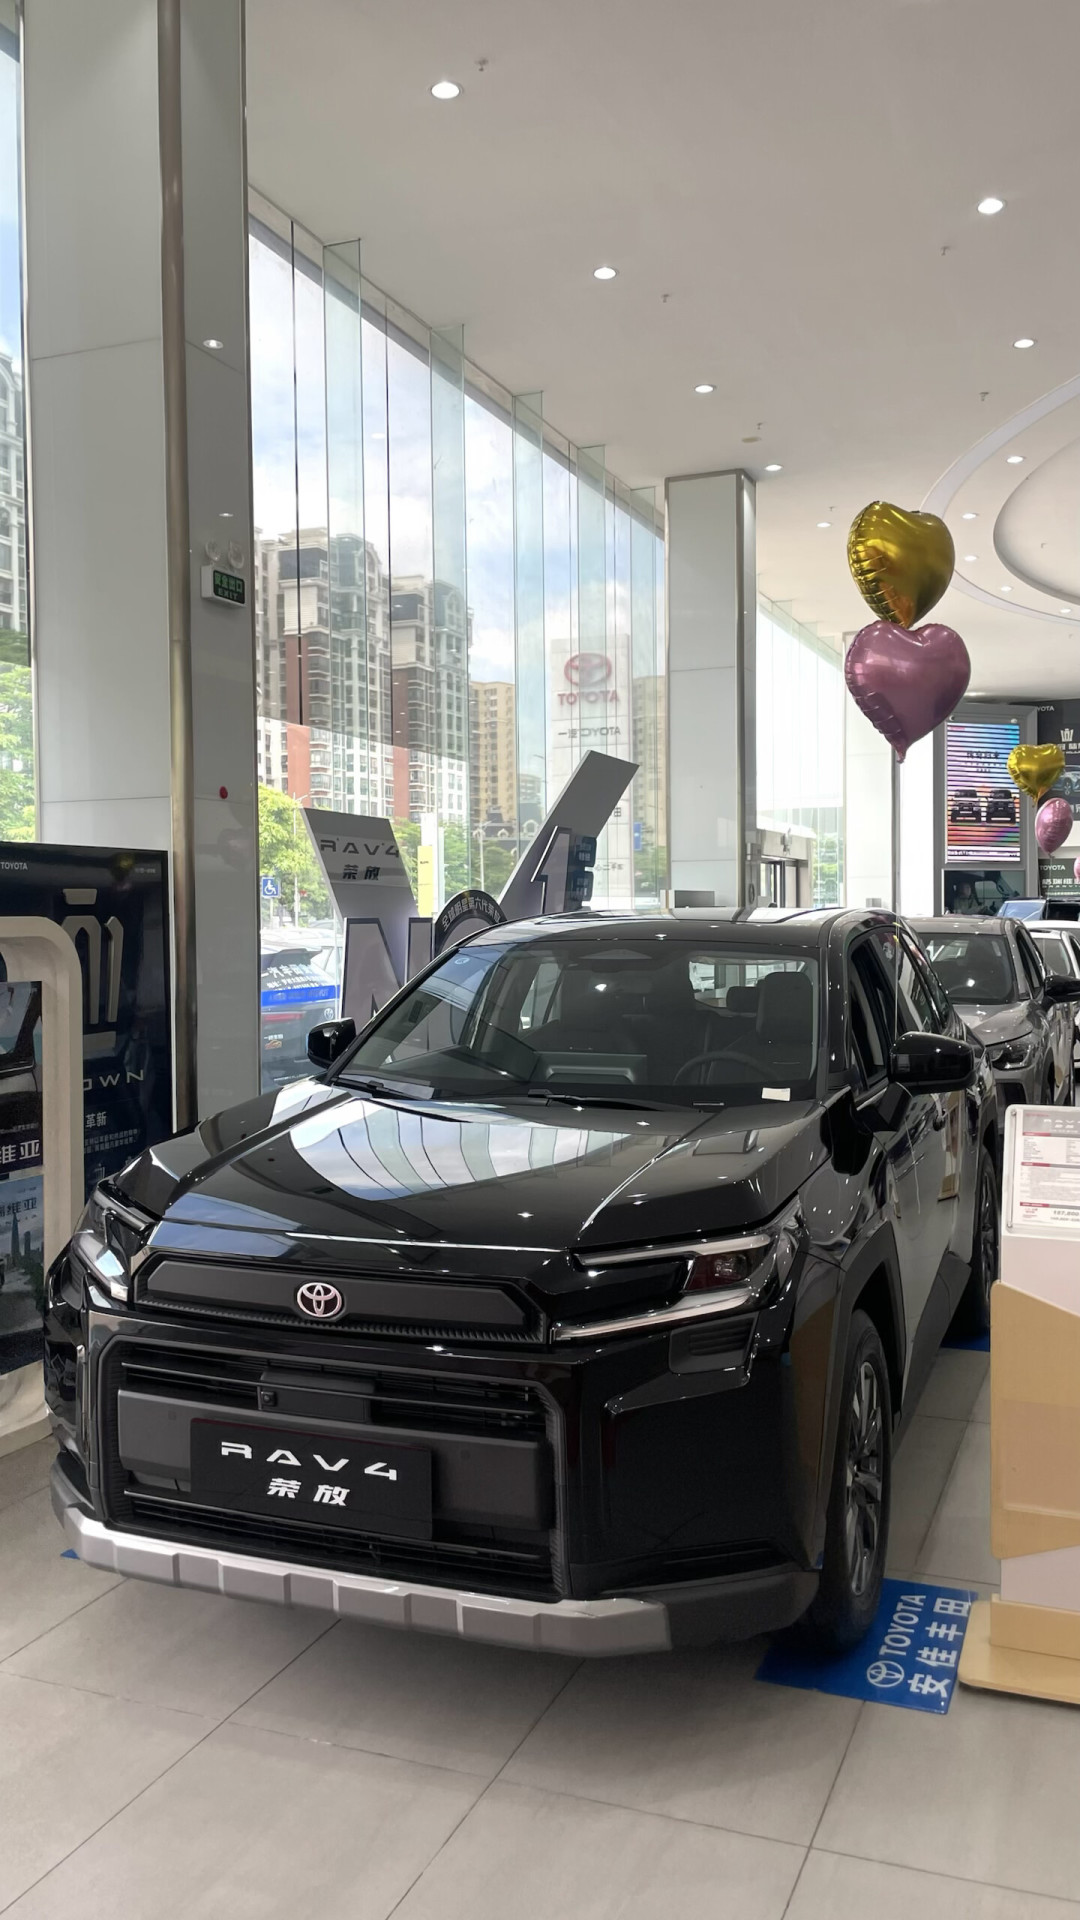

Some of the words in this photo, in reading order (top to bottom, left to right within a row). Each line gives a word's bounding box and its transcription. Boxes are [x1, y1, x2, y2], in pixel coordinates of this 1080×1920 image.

[218, 587, 238, 601] EXIT
[320, 839, 400, 859] RAV4
[0, 861, 28, 870] TOYOTA
[342, 864, 381, 882] 荣放
[85, 1111, 107, 1128] 革新
[221, 1441, 398, 1481] RAV4
[267, 1478, 351, 1506] 荣放
[879, 1595, 926, 1656] TOYOTA
[907, 1597, 971, 1698] 安佳丰田
